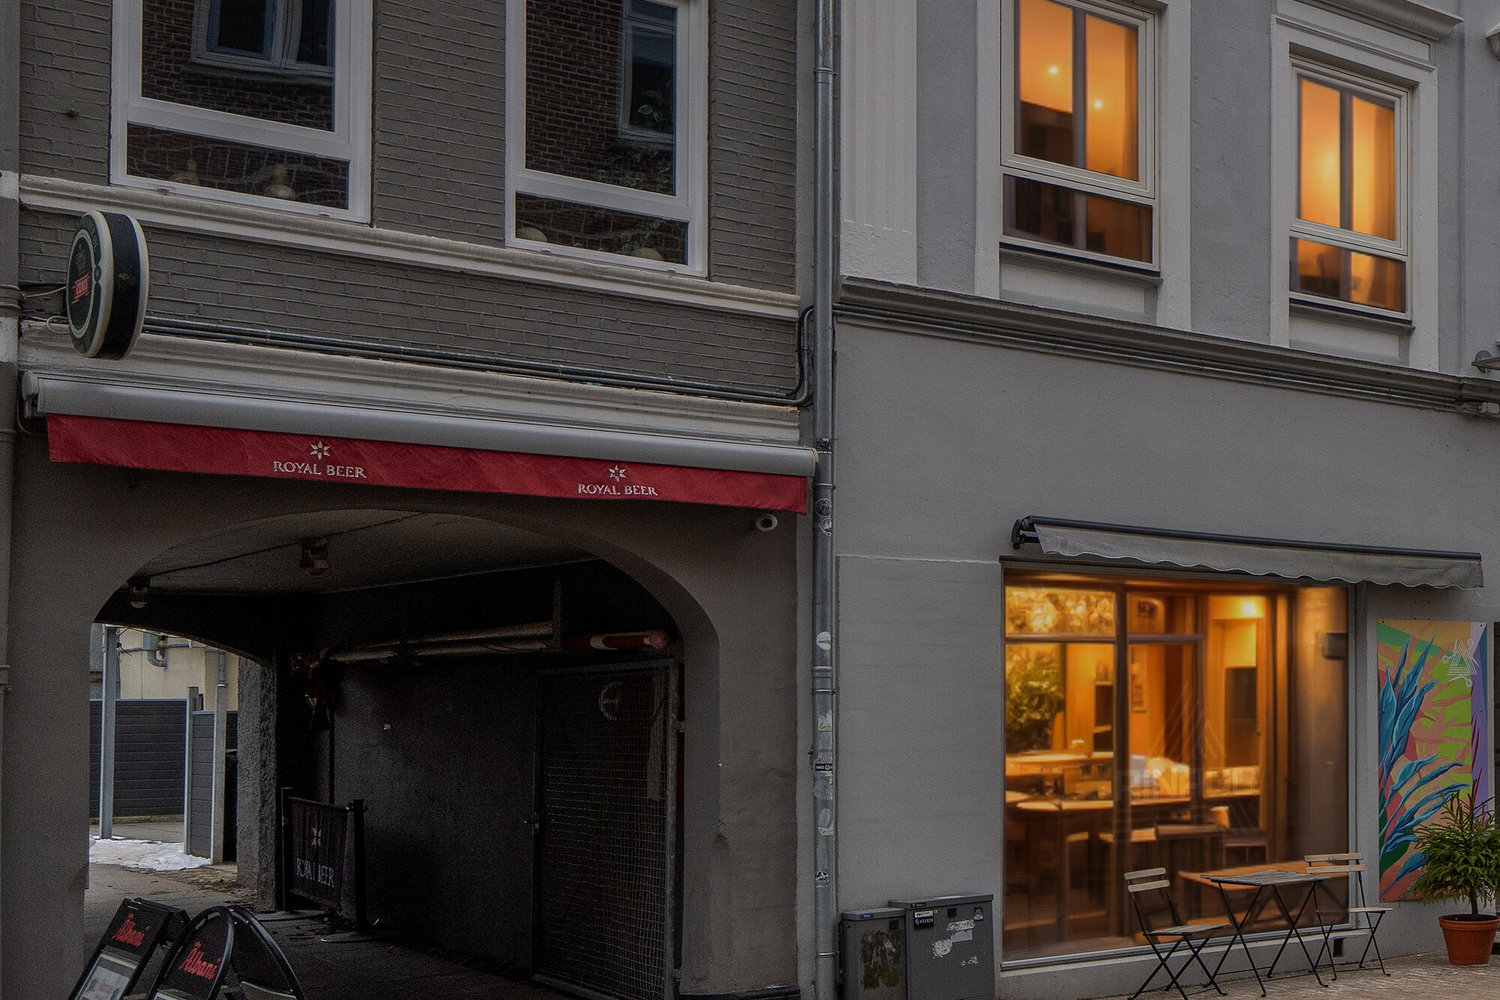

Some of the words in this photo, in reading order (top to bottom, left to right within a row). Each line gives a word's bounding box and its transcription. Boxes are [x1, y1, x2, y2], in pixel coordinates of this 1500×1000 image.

[273, 460, 322, 475] ROYAL
[326, 464, 367, 479] BEER
[577, 483, 621, 495] ROYAL
[624, 485, 658, 497] BEER
[112, 913, 150, 947] Albani
[178, 941, 222, 980] Albani
